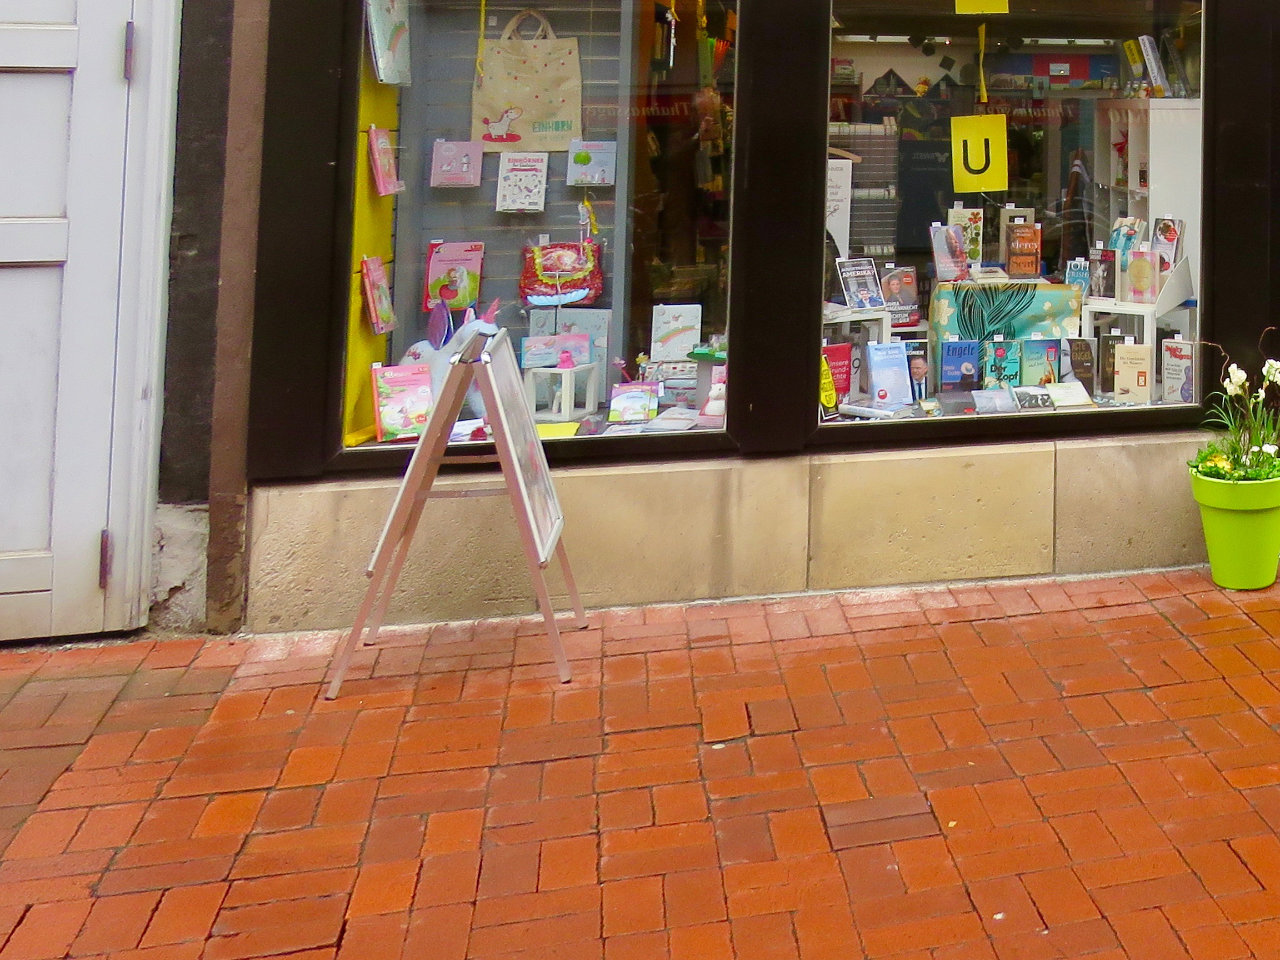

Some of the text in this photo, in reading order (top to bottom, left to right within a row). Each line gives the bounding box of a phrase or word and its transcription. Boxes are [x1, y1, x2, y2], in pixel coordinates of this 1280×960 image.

[532, 120, 573, 133] EINHORN
[962, 138, 991, 174] U
[990, 364, 1007, 373] Der
[997, 371, 1018, 384] Zopf
